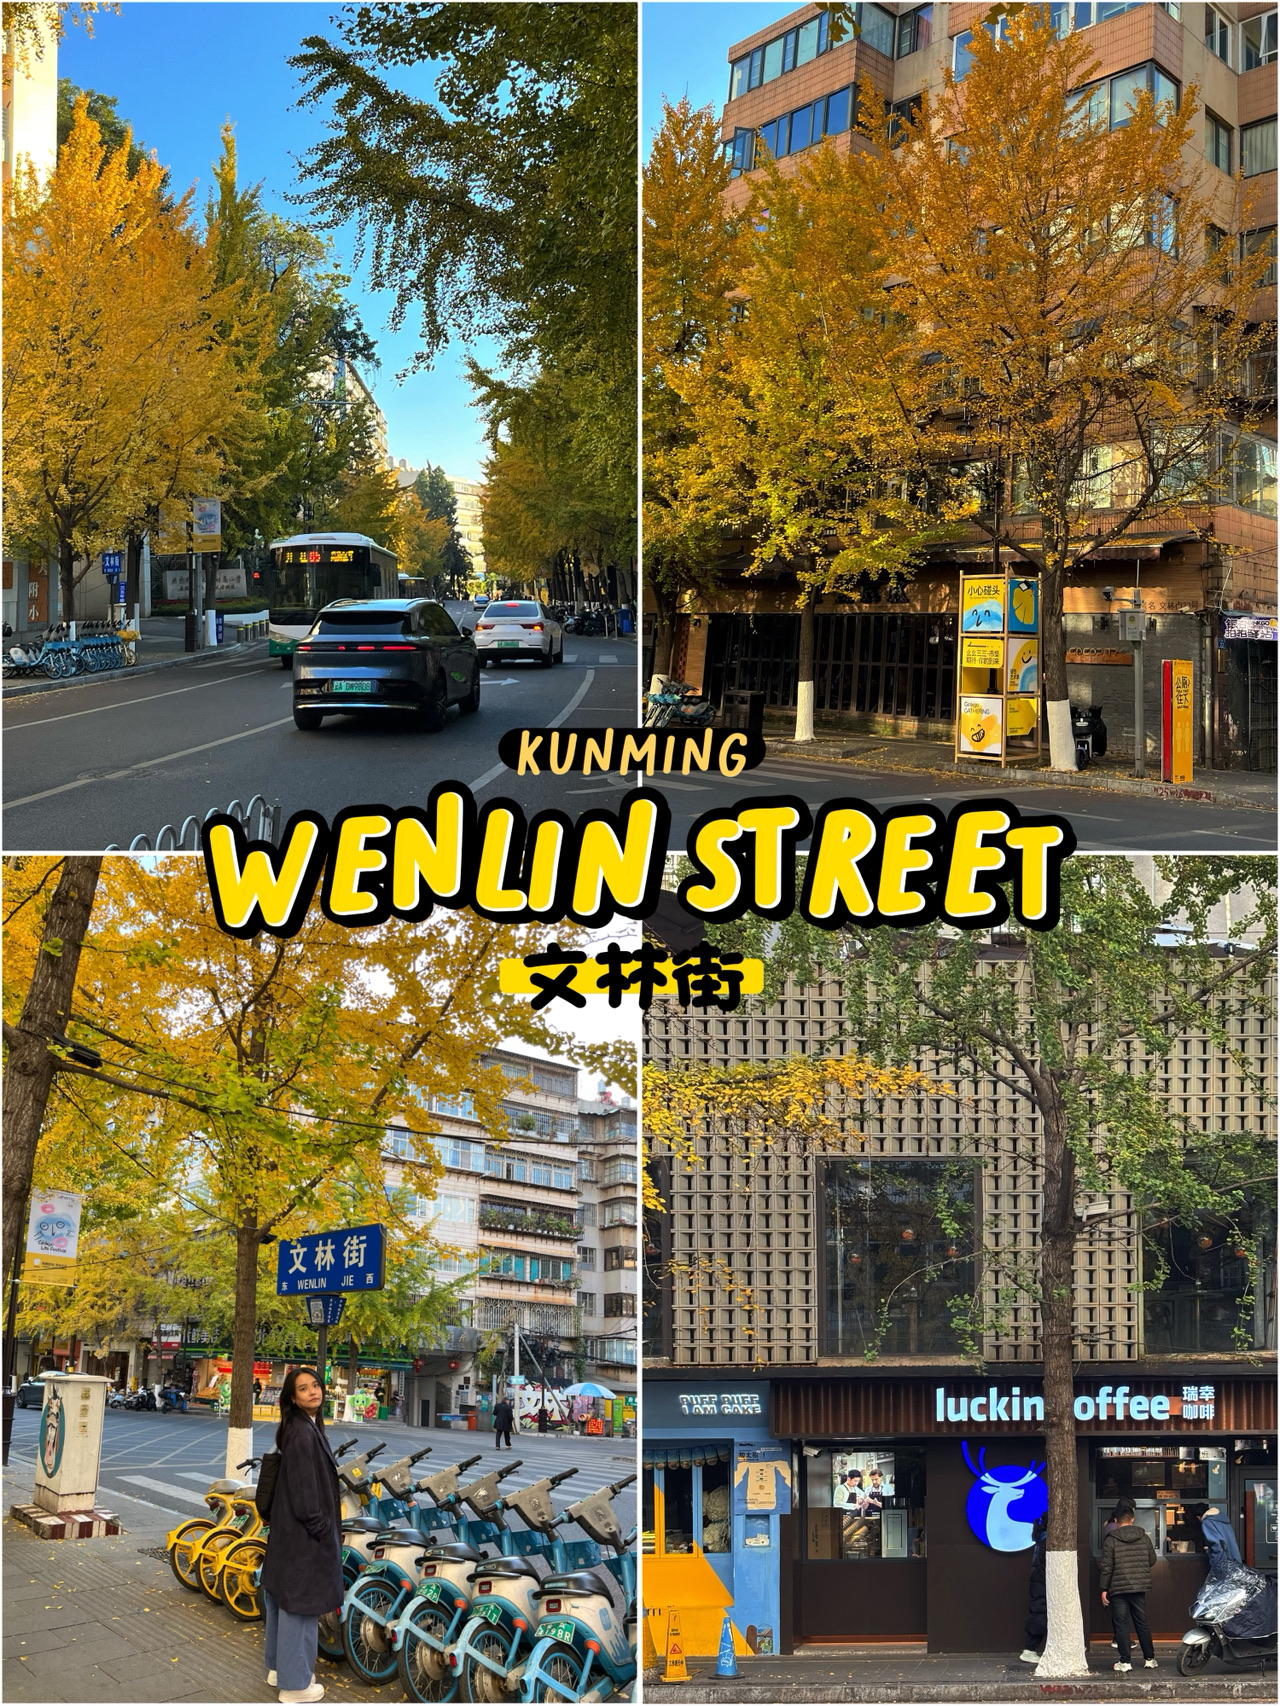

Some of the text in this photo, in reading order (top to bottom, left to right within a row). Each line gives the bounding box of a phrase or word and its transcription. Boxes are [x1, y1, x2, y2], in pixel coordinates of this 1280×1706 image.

[967, 584, 1001, 596] 小心碰头
[963, 701, 980, 709] Ginkgo
[288, 1235, 367, 1275] 文林街
[281, 1273, 375, 1292] 东 WENLIN JIE 西
[679, 1393, 759, 1406] PUFF PUFF
[1182, 1385, 1215, 1401] 瑞幸
[682, 1403, 762, 1415] I AM CAKE
[936, 1386, 1170, 1421] luckin offee
[1182, 1403, 1215, 1420] 咖啡
